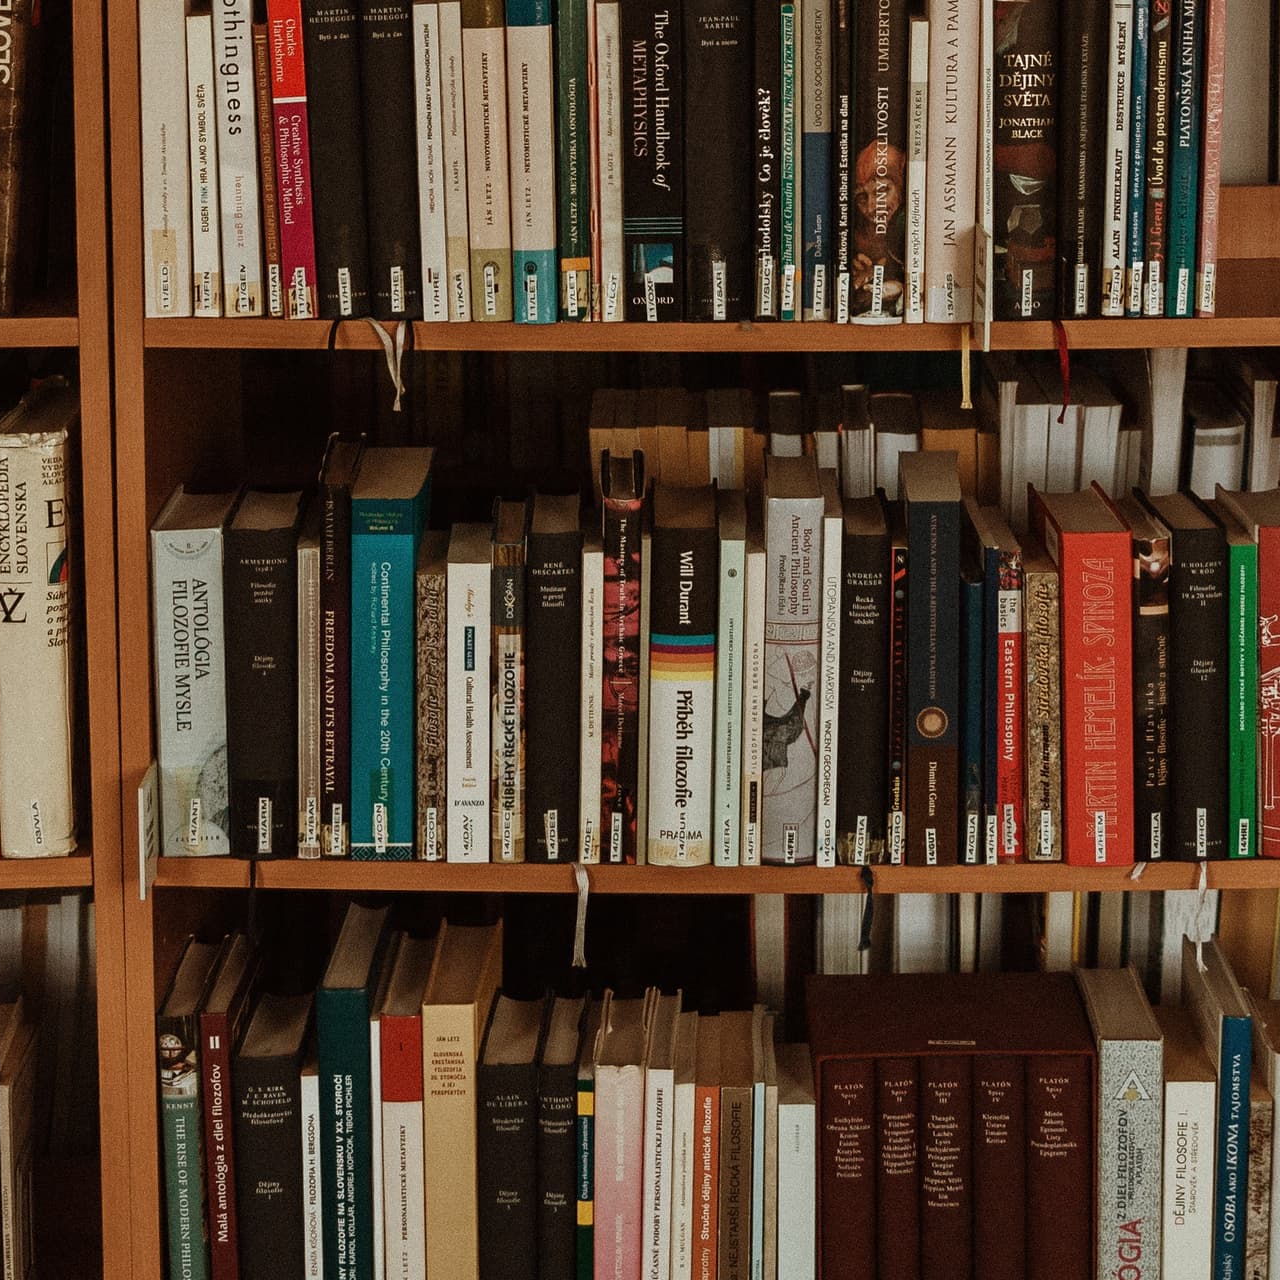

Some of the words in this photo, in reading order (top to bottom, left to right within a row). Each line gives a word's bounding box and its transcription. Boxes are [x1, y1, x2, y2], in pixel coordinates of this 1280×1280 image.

[1004, 51, 1052, 69] TAJNÉ
[633, 39, 647, 158] METAPHYSICS
[1003, 91, 1051, 107] SVĚTA
[680, 551, 693, 579] Will
[172, 579, 190, 672] FILOZOFIE
[679, 581, 693, 625] Durant
[193, 578, 211, 680] ANTOLÓGIA
[174, 674, 193, 732] MYSLE
[676, 690, 694, 740] Příběh
[675, 745, 693, 808] filozofie
[211, 1064, 223, 1116] filozofov
[213, 1119, 225, 1141] diel
[215, 1152, 226, 1210] antológia
[218, 1209, 229, 1242] Malá
